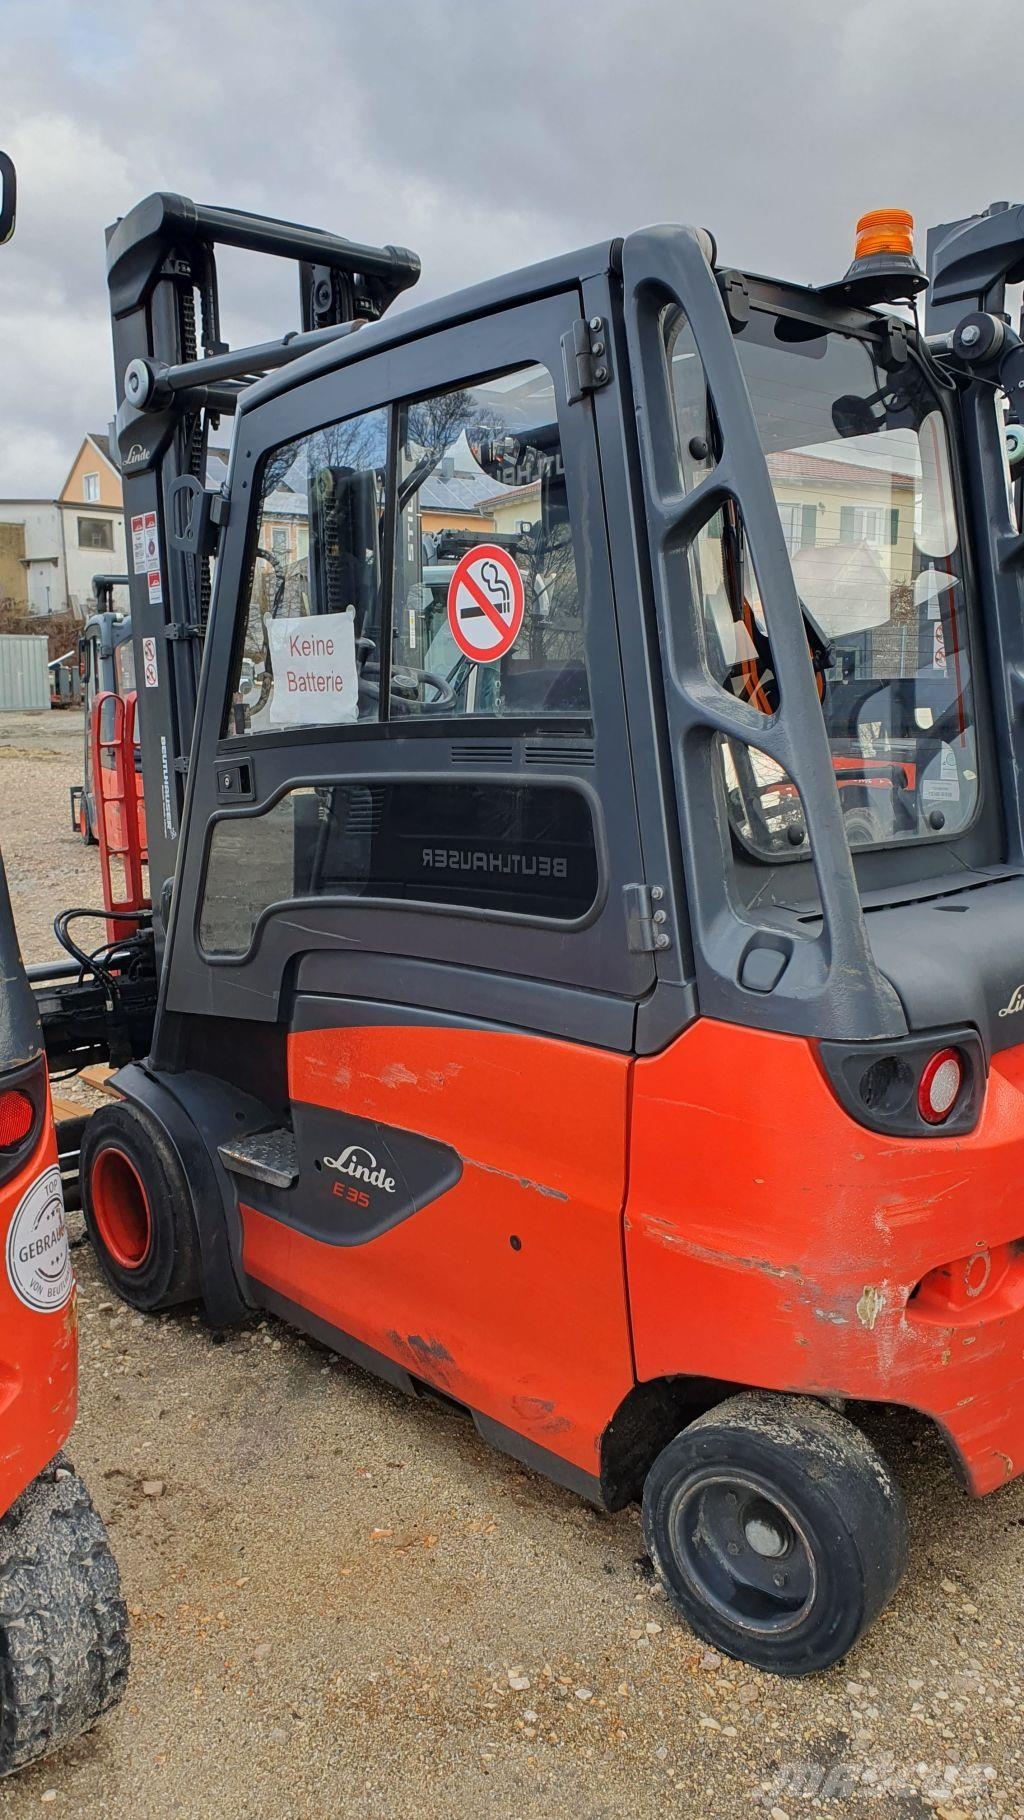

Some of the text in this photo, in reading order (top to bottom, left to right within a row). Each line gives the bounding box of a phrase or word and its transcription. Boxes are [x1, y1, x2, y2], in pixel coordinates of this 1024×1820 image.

[123, 444, 151, 466] Linde
[289, 634, 334, 657] Keine
[286, 670, 343, 692] Batterie
[323, 1145, 396, 1193] Linde
[44, 1179, 57, 1196] TOP
[332, 1181, 370, 1208] E 35
[30, 1278, 44, 1295] VON
